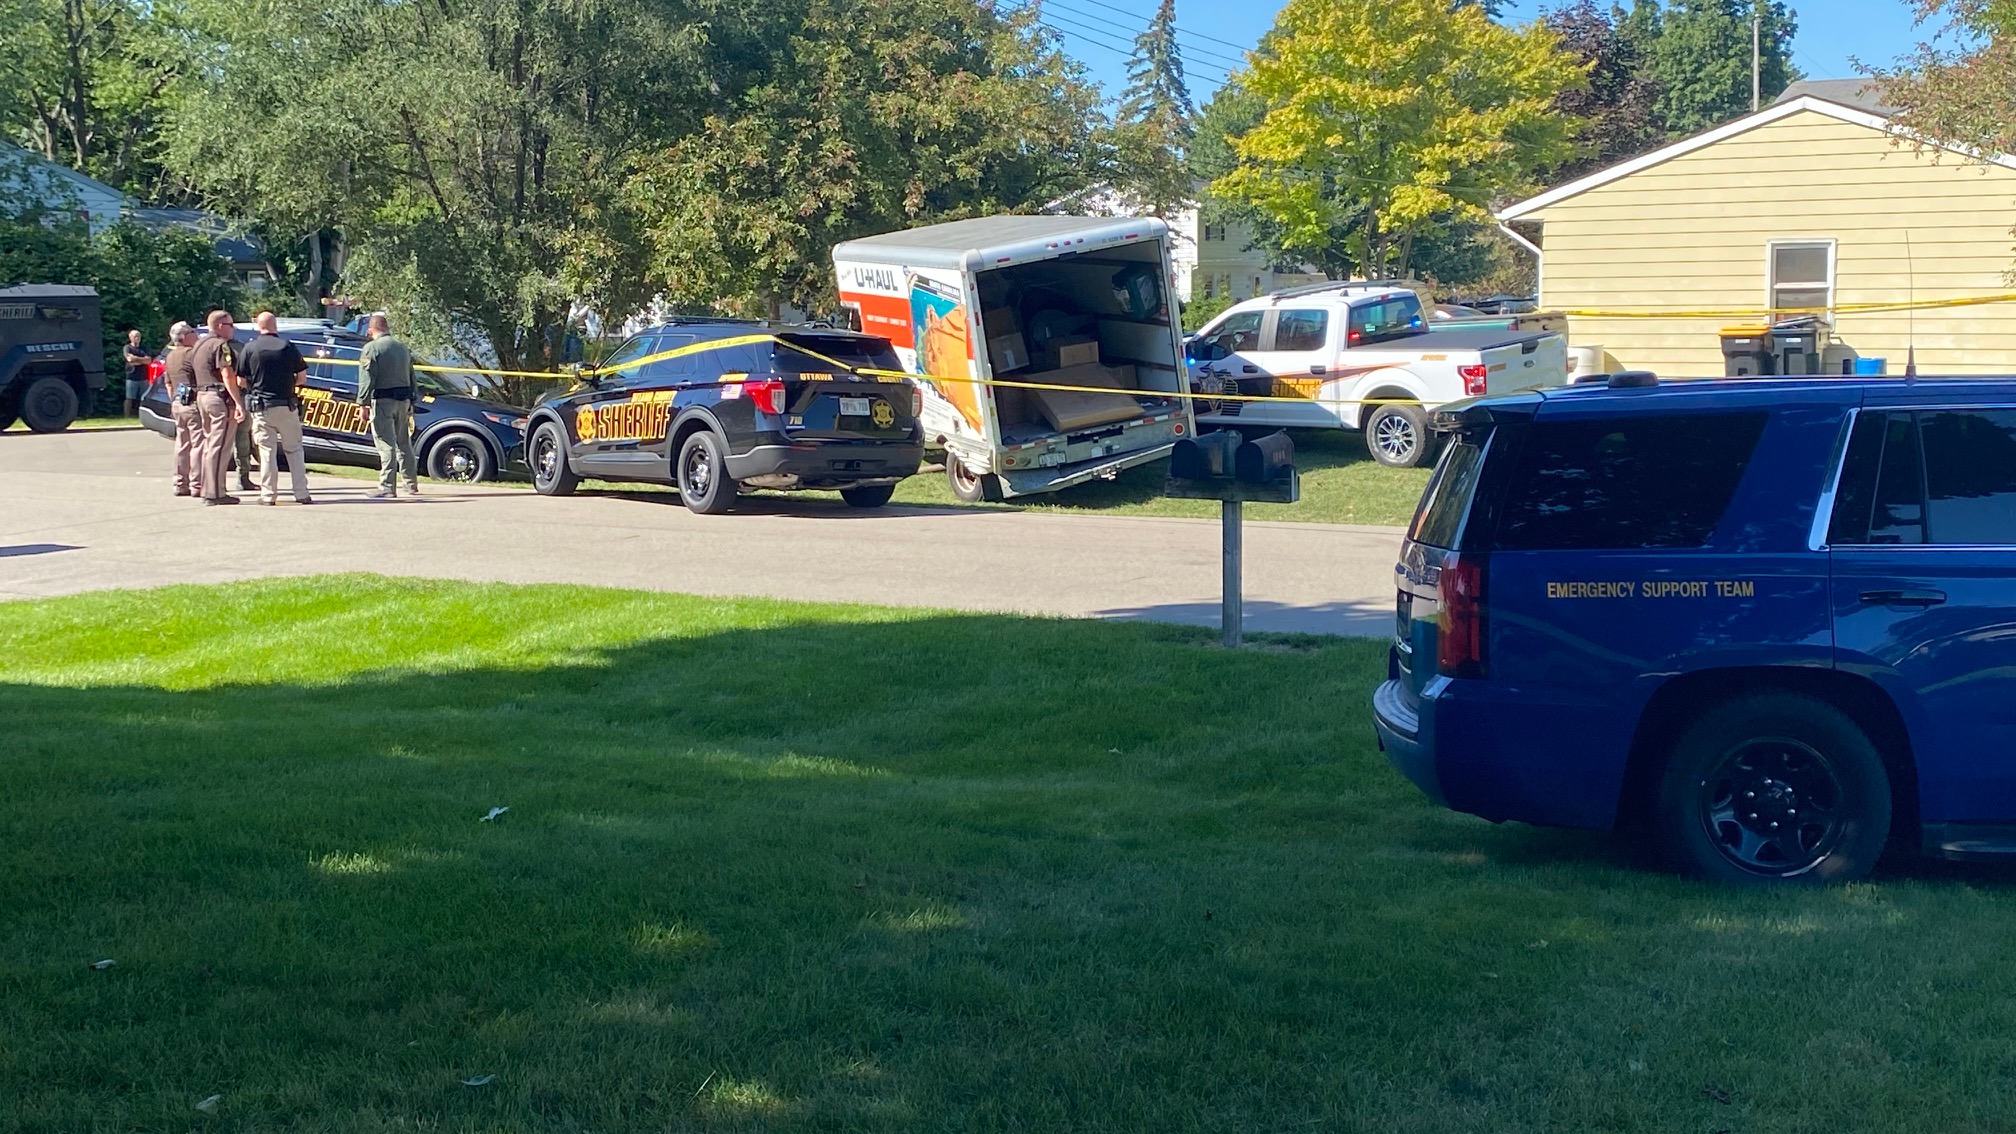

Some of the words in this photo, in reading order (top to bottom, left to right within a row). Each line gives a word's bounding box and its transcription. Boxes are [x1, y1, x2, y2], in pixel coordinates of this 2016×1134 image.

[854, 267, 899, 292] U-HAUL
[26, 342, 76, 353] RESCUE
[800, 373, 833, 381] OTTAWA
[598, 401, 671, 441] SHERIFF
[1547, 582, 1635, 598] EMERGENCY
[1642, 581, 1708, 597] SUPPORT
[1714, 581, 1754, 597] TEAM
